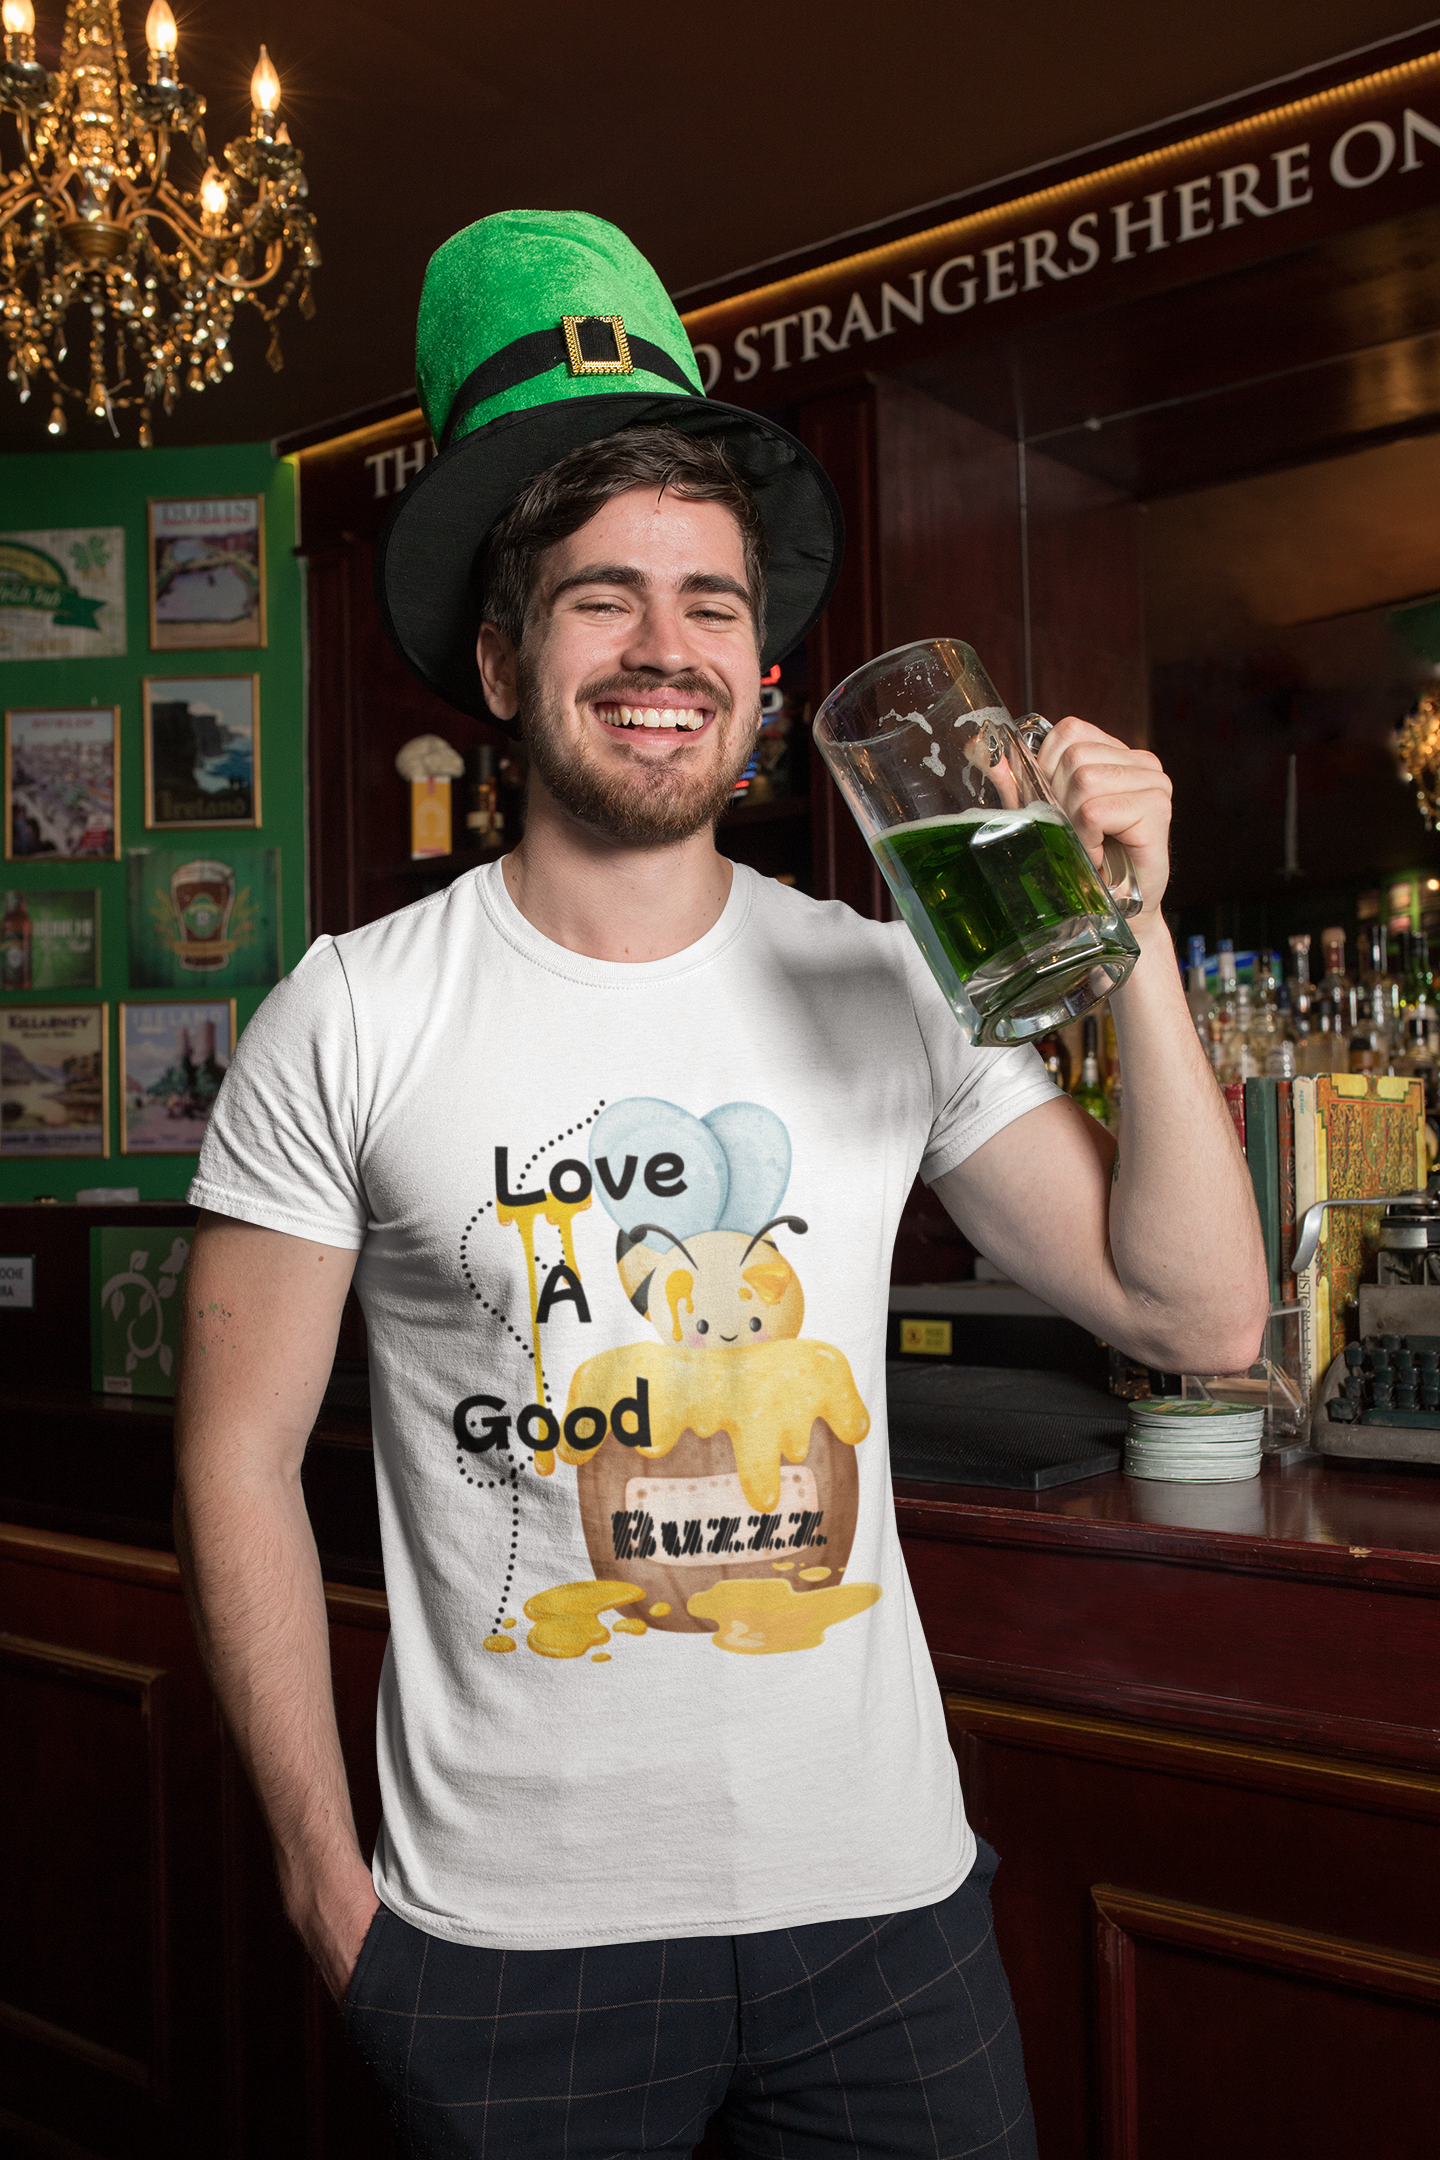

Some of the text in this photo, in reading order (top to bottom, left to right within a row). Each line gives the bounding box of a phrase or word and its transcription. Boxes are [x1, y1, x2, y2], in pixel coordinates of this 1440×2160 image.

[364, 437, 438, 499] TH
[734, 212, 1101, 383] STRANGERS
[1110, 142, 1313, 263] HERE
[495, 1146, 688, 1207] Love
[535, 1264, 592, 1323] A
[453, 1377, 652, 1453] Good
